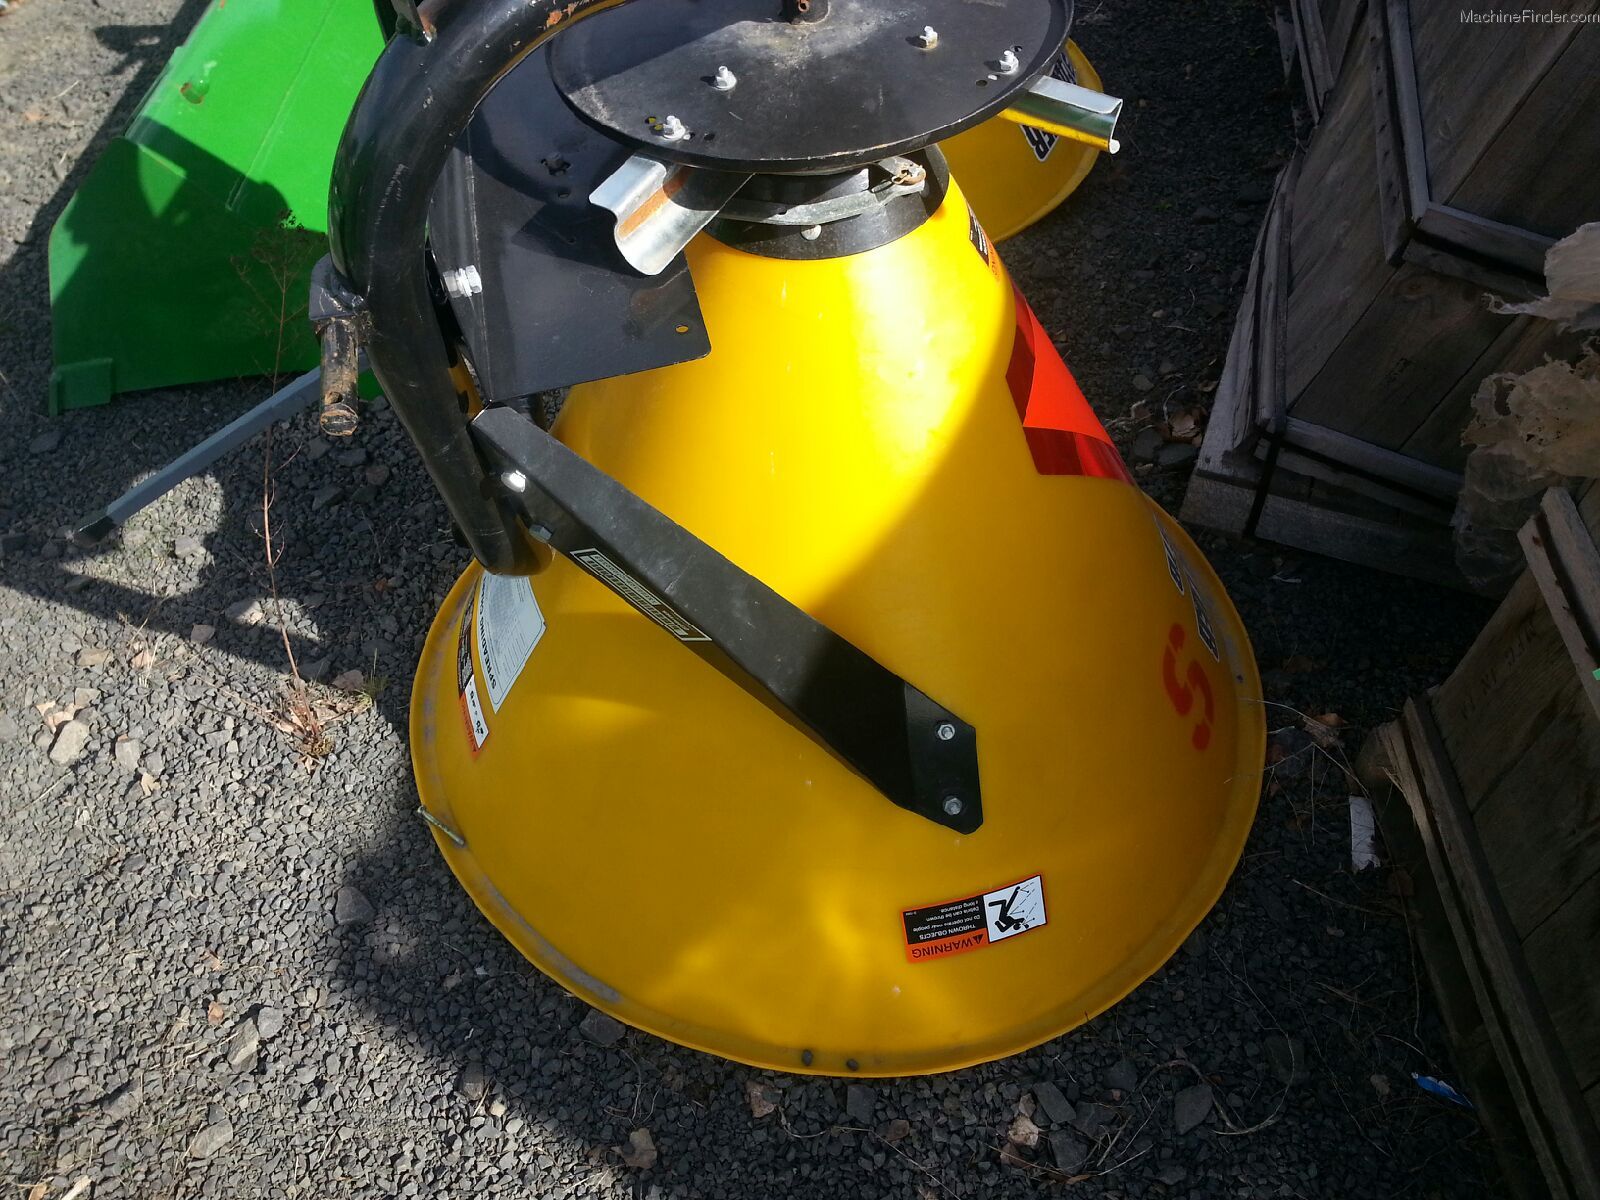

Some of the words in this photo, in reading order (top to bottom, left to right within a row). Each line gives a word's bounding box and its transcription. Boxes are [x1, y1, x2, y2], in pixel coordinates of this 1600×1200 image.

[479, 617, 498, 690] SPREADING
[926, 914, 945, 922] thrown
[948, 924, 976, 934] THROWN
[919, 930, 947, 940] OBJECTS
[911, 937, 974, 958] WARNING
